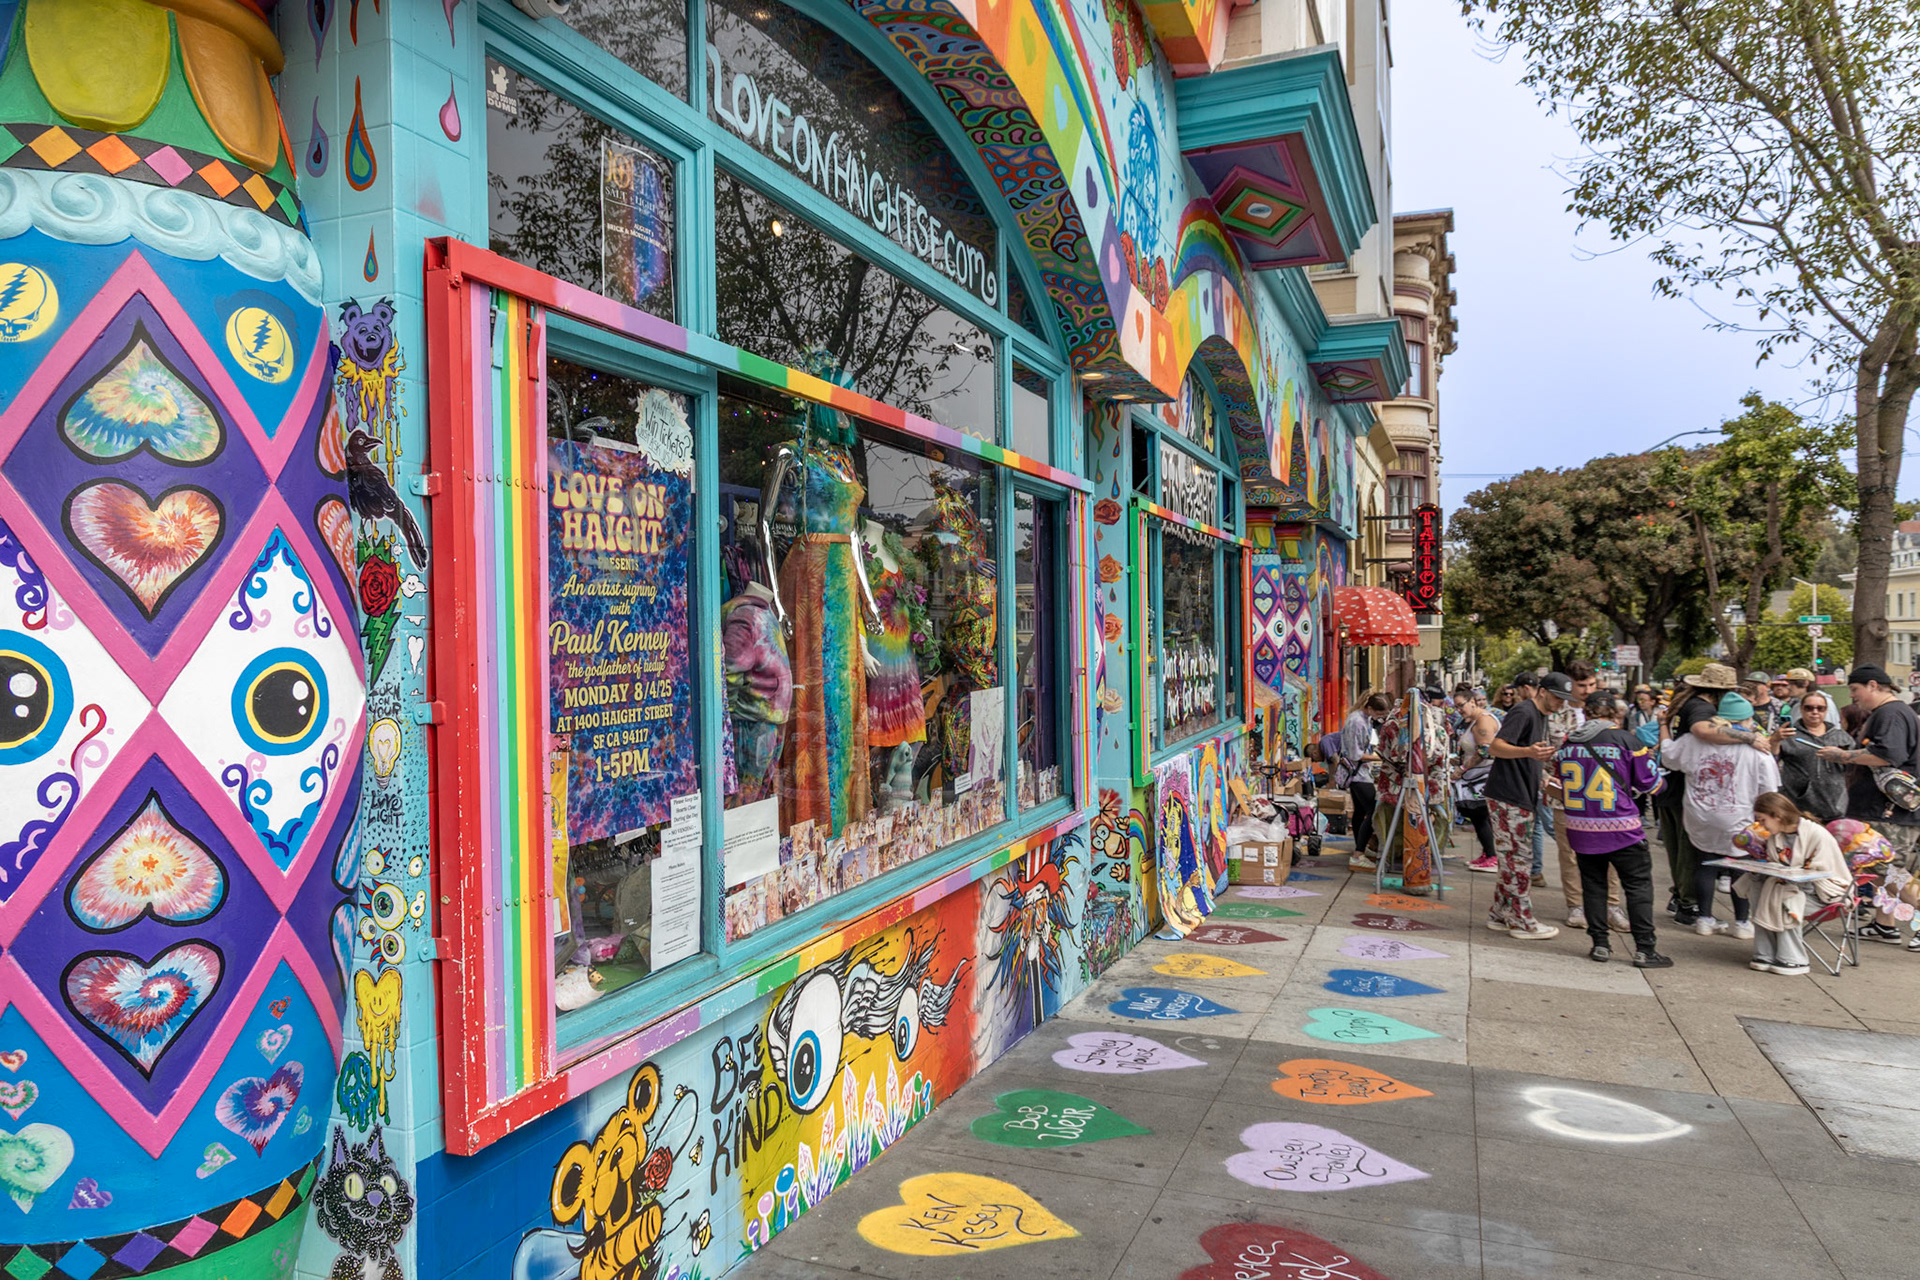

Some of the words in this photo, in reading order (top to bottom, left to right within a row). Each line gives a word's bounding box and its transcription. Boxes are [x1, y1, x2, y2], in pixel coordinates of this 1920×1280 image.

[487, 97, 518, 115] DUMB
[605, 186, 628, 200] SALT
[651, 398, 670, 420] WANT
[553, 470, 624, 514] LOVE
[634, 480, 667, 520] ON
[562, 510, 663, 555] HAIGHT
[1419, 511, 1436, 599] TATTOO
[561, 574, 587, 598] An
[587, 578, 622, 598] artist
[622, 580, 657, 605] signing
[610, 600, 631, 616] with
[549, 620, 604, 656] Paul
[606, 619, 671, 660] Kenney
[585, 658, 633, 684] godfather
[632, 660, 643, 679] of
[564, 682, 629, 709] MONDAY
[634, 679, 672, 701] 8/4/25
[556, 716, 573, 733] AT
[574, 712, 600, 730] 1400
[601, 707, 642, 727] HAIGHT
[644, 702, 674, 721] STREET
[593, 733, 606, 750] SF
[606, 731, 621, 747] CA
[622, 727, 649, 745] 94117
[595, 747, 651, 782] 1-5PM
[1560, 760, 1618, 812] 24
[367, 807, 405, 829] LIGHT
[1074, 1038, 1134, 1066] Stanley
[1298, 1068, 1350, 1098] Timothy
[1263, 1138, 1323, 1181] Owsley
[1309, 1142, 1388, 1185] Stanley
[899, 1193, 967, 1232] KEN
[930, 1203, 1047, 1250] Kesey
